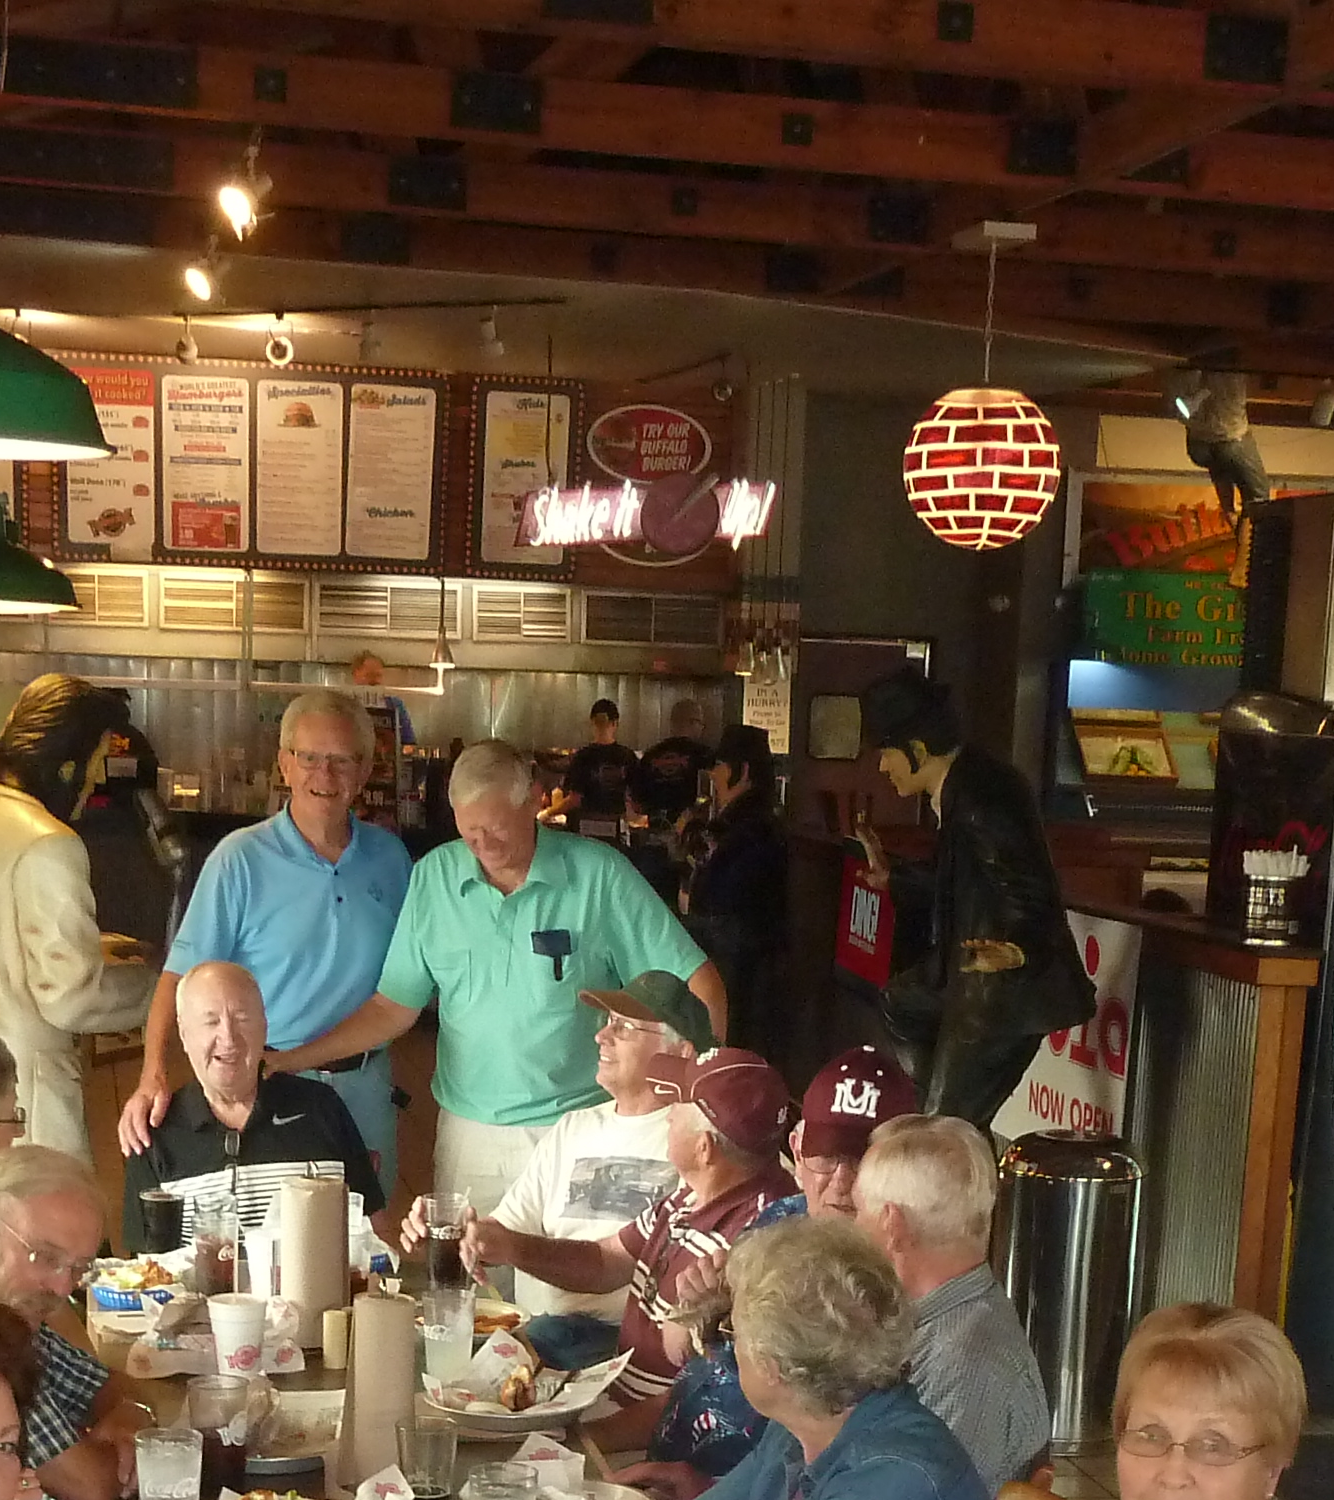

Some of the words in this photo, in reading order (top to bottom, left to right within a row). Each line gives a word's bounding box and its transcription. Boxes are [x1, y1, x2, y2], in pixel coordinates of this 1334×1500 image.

[96, 373, 128, 385] would
[129, 376, 149, 388] you
[104, 387, 146, 400] cooked?
[386, 393, 427, 408] Salads
[642, 423, 664, 438] TRY
[666, 423, 691, 438] OUR
[640, 439, 688, 455] BUFFALO
[641, 455, 691, 472] BURGER!
[367, 507, 415, 519] Chicken
[529, 480, 610, 547] Shake
[721, 478, 776, 552] Up!
[1120, 590, 1182, 621] The
[1196, 594, 1241, 622] Gr
[1147, 625, 1203, 645] Farm
[771, 688, 778, 697] A
[1028, 1079, 1064, 1126] NOW
[1069, 1097, 1114, 1137] OPEN
